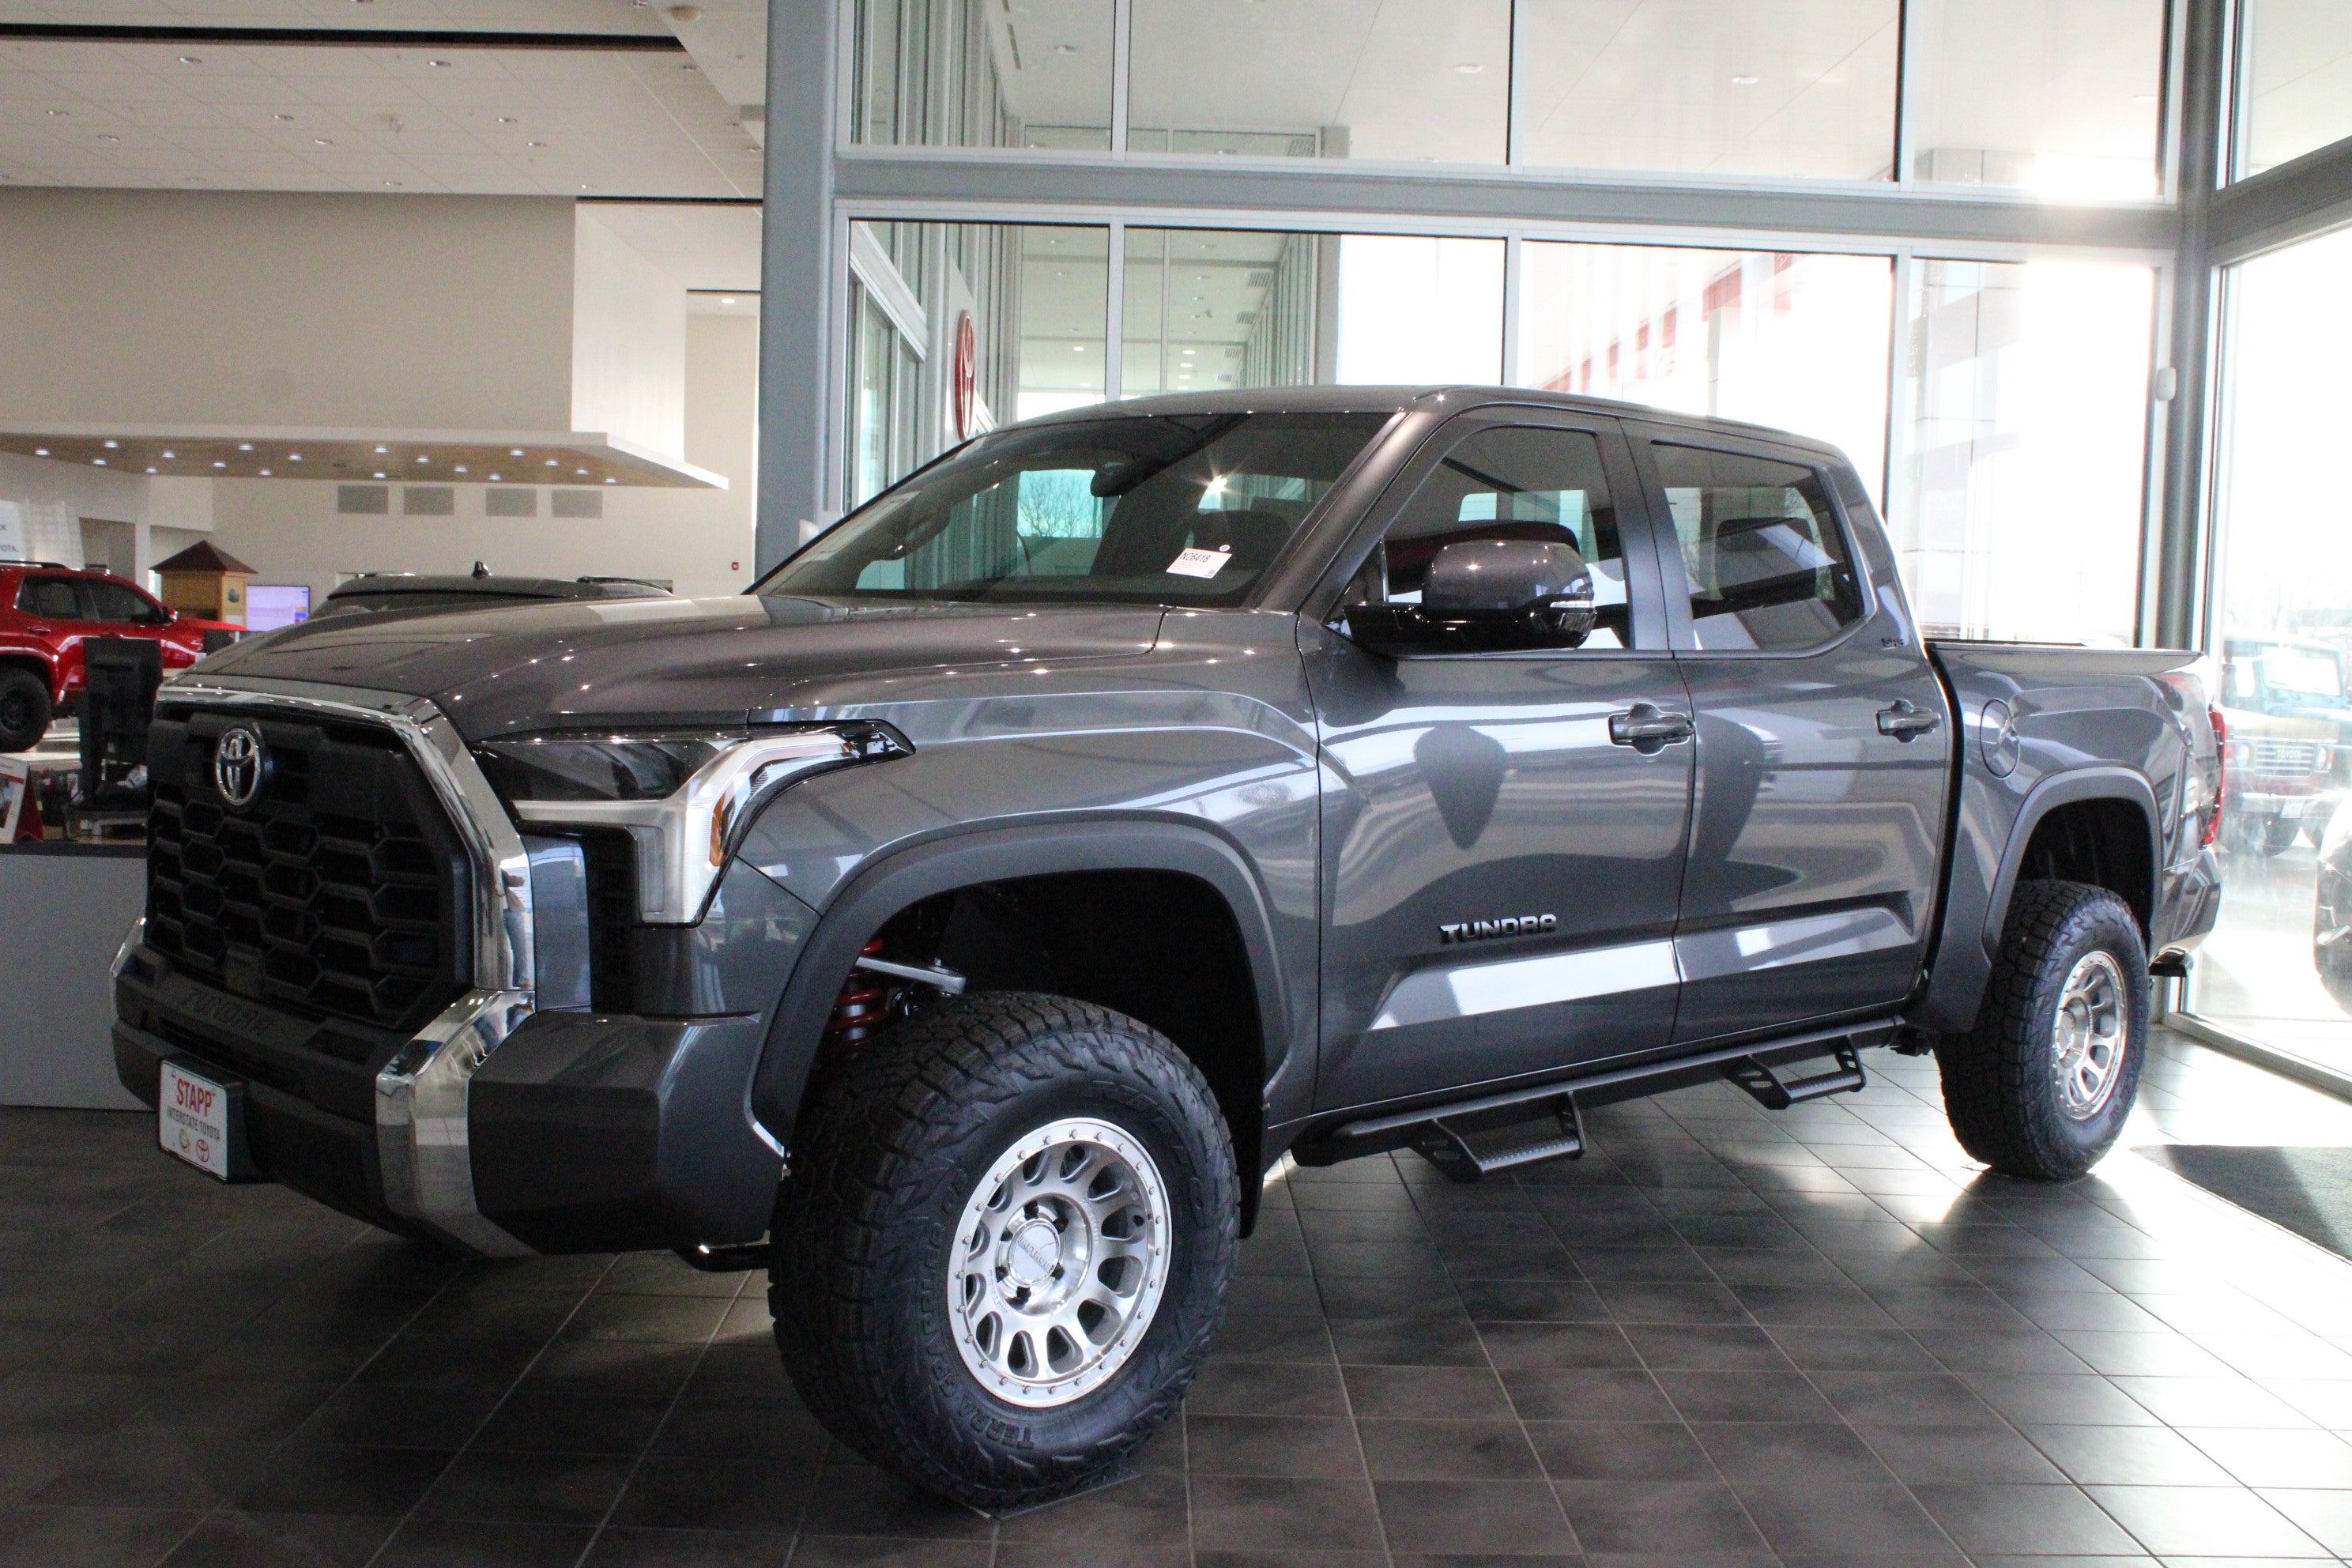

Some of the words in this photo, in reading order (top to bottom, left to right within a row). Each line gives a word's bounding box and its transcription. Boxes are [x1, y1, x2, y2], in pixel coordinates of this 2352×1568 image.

[2275, 749, 2301, 760] TOYOTA
[1438, 914, 1558, 944] TUNDRA
[176, 1078, 213, 1117] STAPP
[167, 1106, 198, 1132] INTERSTATE
[199, 1121, 220, 1142] TOYOTA
[957, 1393, 1035, 1449] TERRA
